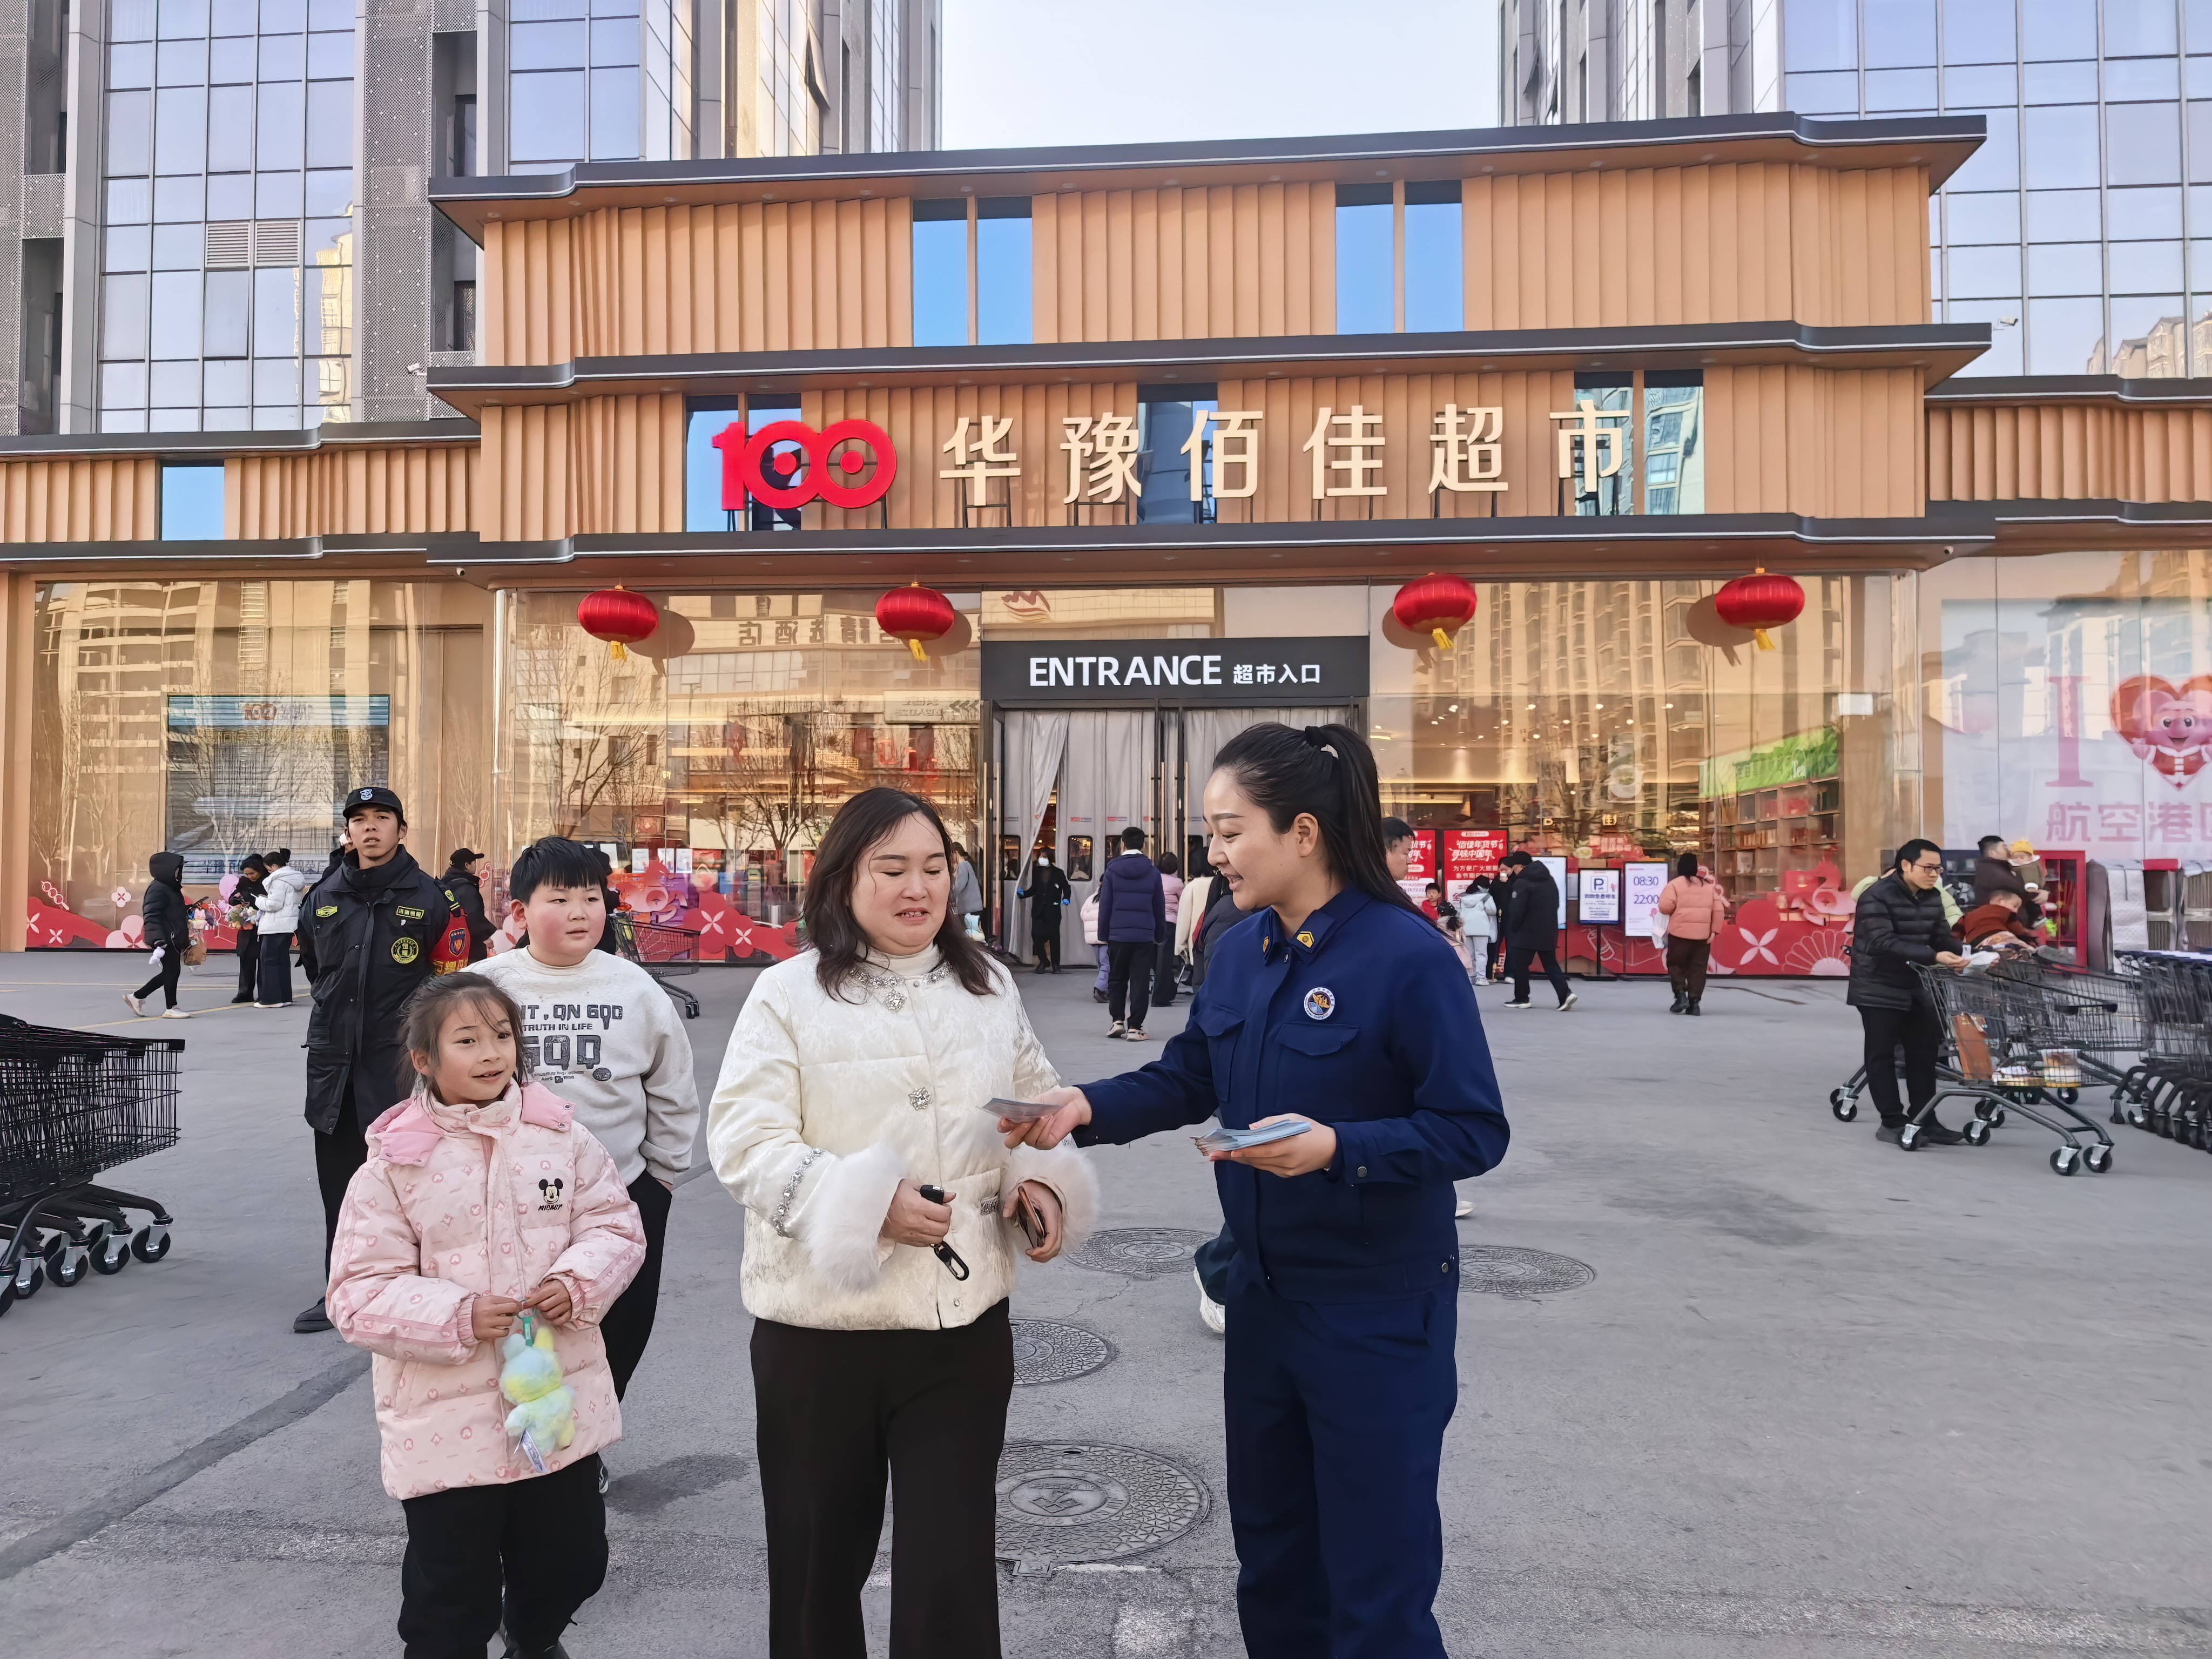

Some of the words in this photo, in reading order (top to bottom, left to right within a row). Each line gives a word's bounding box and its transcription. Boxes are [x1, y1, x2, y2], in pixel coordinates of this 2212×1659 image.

[712, 419, 897, 511] 100
[939, 400, 1630, 507] 华豫佰佳超市
[1029, 655, 1222, 687] ENTRANCE
[1233, 664, 1321, 685] 超市入口
[2045, 801, 2212, 843] 航空港
[1594, 878, 1604, 890] P
[1634, 876, 1659, 886] 08:30
[1634, 895, 1659, 904] 22:00
